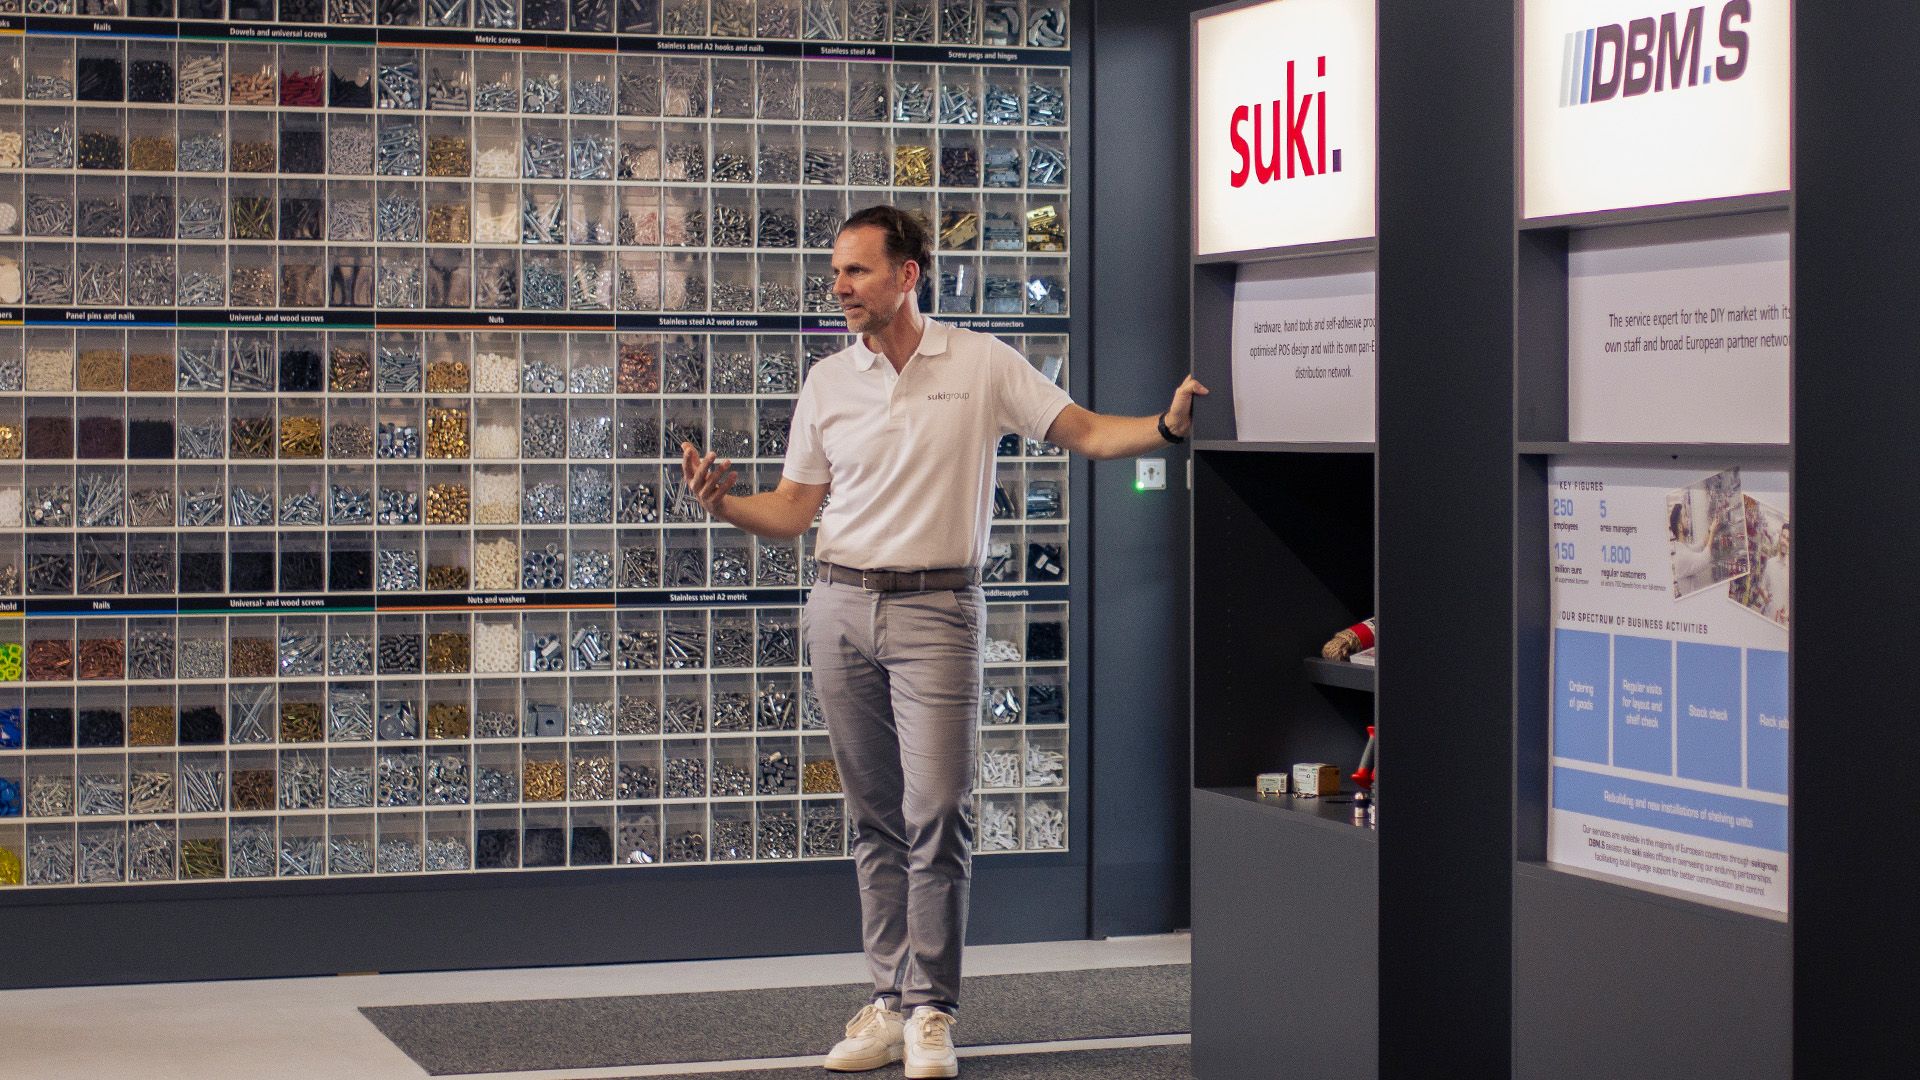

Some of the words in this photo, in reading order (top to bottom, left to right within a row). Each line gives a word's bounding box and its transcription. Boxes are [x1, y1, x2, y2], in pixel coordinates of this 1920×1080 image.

[94, 23, 111, 31] Nails
[229, 28, 255, 36] Dowels
[256, 28, 270, 36] and
[271, 29, 302, 38] universal
[475, 35, 496, 44] Metric
[657, 42, 686, 50] Stainless
[687, 42, 703, 50] steel
[821, 46, 849, 55] Stainless
[866, 48, 876, 56] A4
[1591, 0, 1751, 103] DBM.S
[948, 51, 967, 59] Screw
[968, 52, 984, 60] pegs
[997, 52, 1018, 61] hinges
[66, 311, 86, 320] Panel
[87, 312, 102, 321] pins
[103, 312, 117, 320] and
[118, 312, 135, 320] nails
[229, 313, 264, 322] Universal-
[265, 314, 279, 322] and
[280, 314, 300, 322] wood
[488, 315, 504, 324] Nuts
[1609, 313, 1622, 327] The
[1625, 312, 1651, 327] service
[1653, 311, 1679, 329] expert
[1681, 309, 1692, 325] for
[1694, 308, 1708, 324] the
[1711, 307, 1725, 323] DIY
[1727, 305, 1757, 322] market
[1760, 304, 1779, 320] with
[659, 318, 688, 326] Stainless
[689, 318, 705, 326] steel
[706, 318, 715, 326] A2
[819, 319, 847, 327] Stainless
[960, 320, 971, 328] and
[972, 320, 990, 328] wood
[991, 320, 1024, 328] connectors
[1284, 320, 1298, 332] hand
[1299, 318, 1313, 332] tools
[1314, 318, 1325, 331] and
[1326, 316, 1362, 330] self-adhesive
[1604, 341, 1622, 353] own
[1623, 336, 1642, 353] staff
[1643, 336, 1658, 352] and
[1660, 335, 1684, 351] broad
[1686, 335, 1724, 354] European
[1727, 334, 1758, 352] partner
[1760, 333, 1789, 348] netwo
[1249, 345, 1278, 359] optimised
[1279, 344, 1290, 356] POS
[1291, 342, 1310, 359] design
[1311, 342, 1322, 355] and
[1322, 341, 1335, 354] with
[1336, 341, 1344, 354] its
[1344, 343, 1358, 353] own
[1295, 365, 1327, 379] distribution
[927, 391, 970, 401] sukigroup
[1559, 481, 1572, 490] KEY
[1574, 481, 1604, 491] FIGURES
[1553, 498, 1574, 516] 250
[1599, 500, 1607, 518] 5
[1553, 522, 1579, 532] employees
[1612, 525, 1638, 536] managers
[1554, 542, 1575, 560] 150
[1601, 545, 1631, 564] 1.800
[1554, 564, 1570, 574] million
[1601, 568, 1619, 579] regular
[1620, 570, 1646, 580] customers
[229, 599, 264, 607] Universal-
[266, 598, 279, 607] and
[280, 598, 300, 606] wood
[467, 596, 484, 604] Nuts
[484, 595, 497, 604] and
[498, 595, 526, 604] washers
[670, 593, 699, 602] Stainless
[700, 593, 716, 601] steel
[717, 593, 726, 601] A2
[727, 593, 748, 601] metric
[93, 602, 111, 610] Nails
[1562, 610, 1575, 621] OUR
[1578, 612, 1614, 625] SPECTRUM
[1616, 616, 1625, 626] OF
[1627, 617, 1663, 630] BUSINESS
[1666, 621, 1708, 634] ACTIVITIES
[1569, 680, 1594, 697] Ordering
[1623, 679, 1646, 695] Regular
[1569, 696, 1576, 708] of
[1576, 699, 1594, 711] goods
[1622, 695, 1631, 707] for
[1632, 696, 1650, 712] layout
[1650, 700, 1662, 712] and
[1708, 708, 1728, 721] check
[1641, 715, 1659, 728] check
[1604, 790, 1634, 810] Rebuilding
[1635, 798, 1646, 809] and
[1648, 800, 1660, 811] new
[1661, 801, 1699, 819] installations
[1700, 809, 1707, 820] of
[1708, 810, 1734, 828] shelving
[1735, 816, 1753, 829] units
[1611, 832, 1620, 840] are
[1680, 844, 1704, 857] European
[1630, 860, 1652, 873] language
[1652, 866, 1671, 876] support
